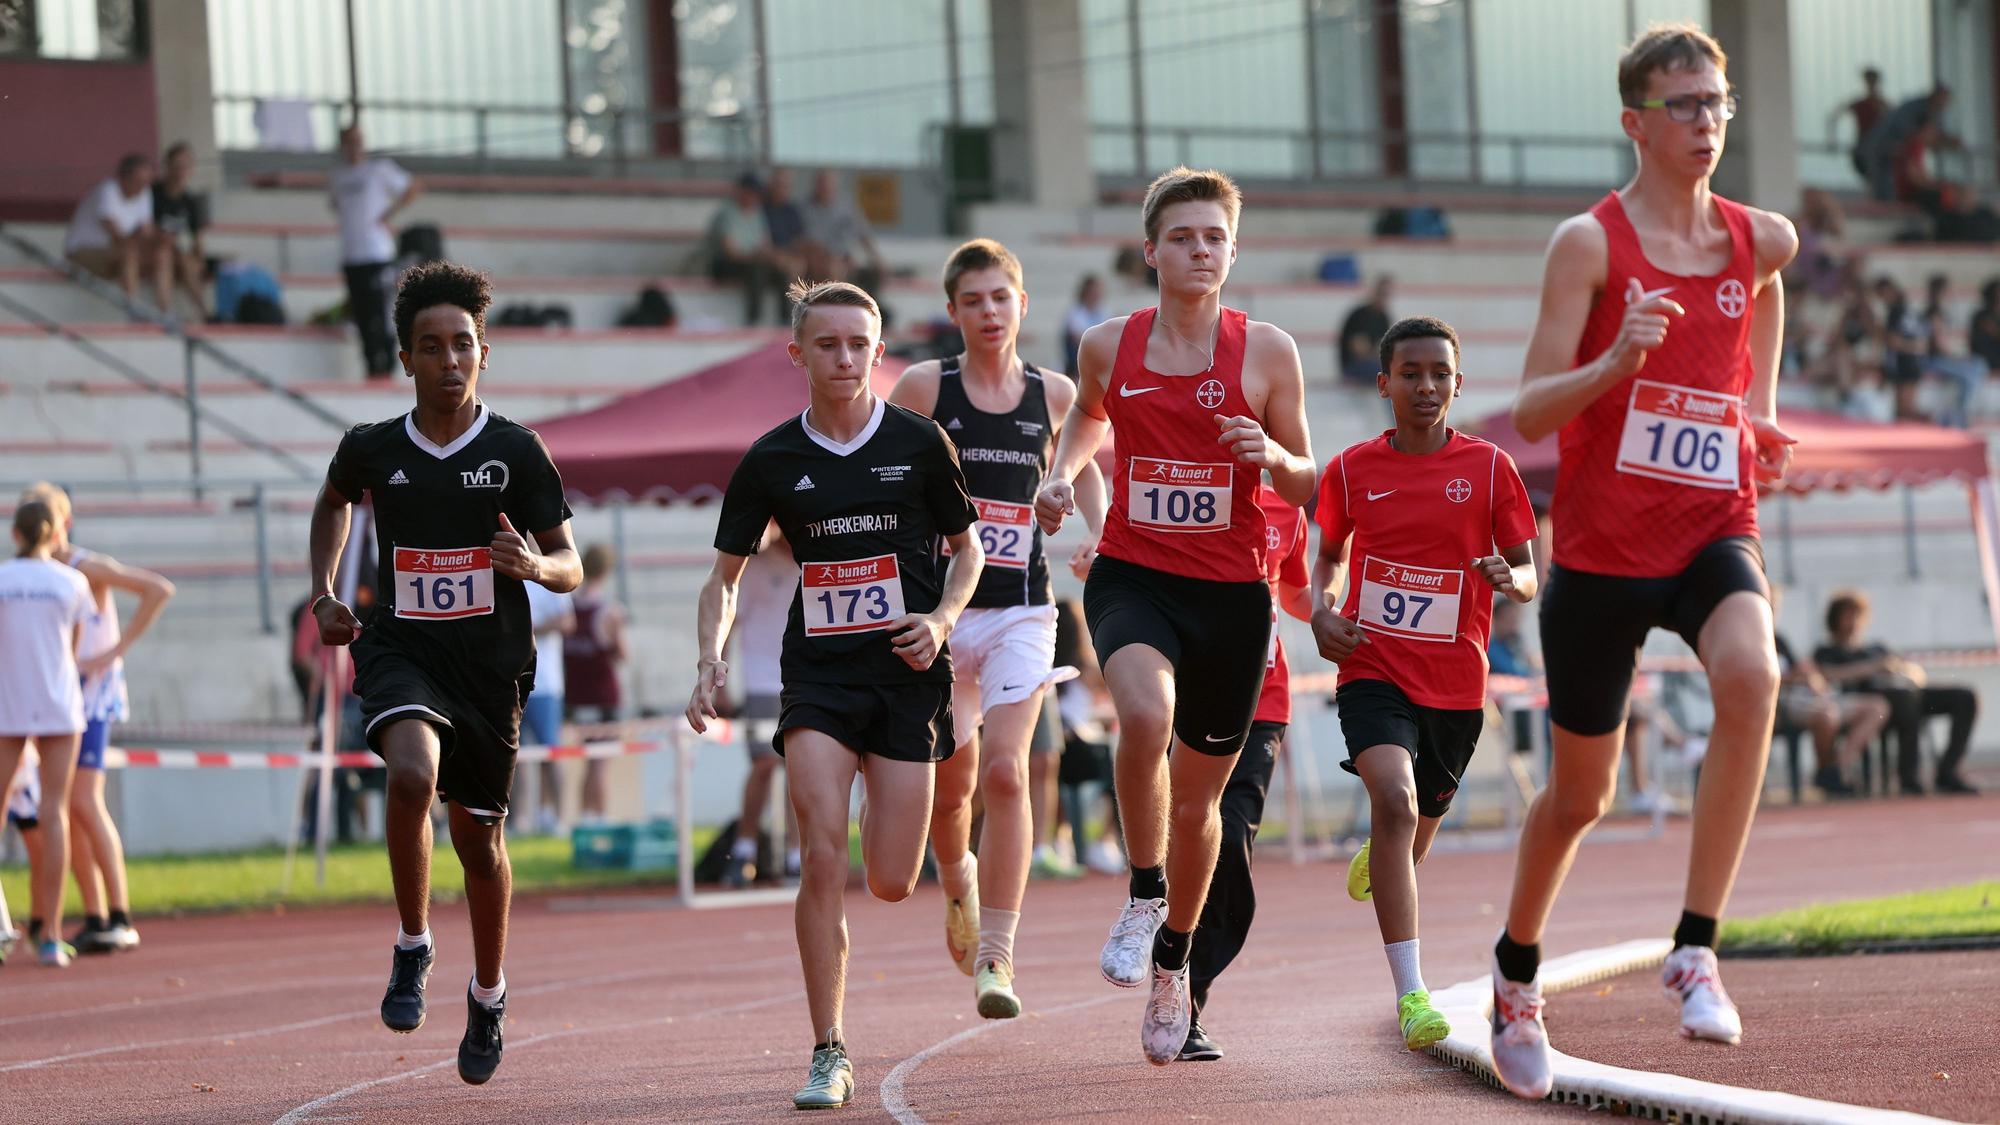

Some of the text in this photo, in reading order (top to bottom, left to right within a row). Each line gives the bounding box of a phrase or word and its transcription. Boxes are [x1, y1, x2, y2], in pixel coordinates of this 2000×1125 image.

[1647, 421, 1723, 473] 106
[962, 448, 1040, 466] HERKENRATH
[460, 471, 491, 485] TVH
[1170, 465, 1213, 479] bunert
[794, 483, 815, 491] adidas
[983, 504, 1019, 519] bunert
[1144, 487, 1216, 524] 108
[806, 514, 897, 538] TV HERKENRATH
[980, 526, 1019, 557] 62
[432, 552, 474, 566] bunert
[837, 561, 878, 578] bunert
[1400, 569, 1444, 587] bunert
[410, 575, 474, 610] 161
[818, 585, 889, 624] 173
[1382, 591, 1433, 629] 97
